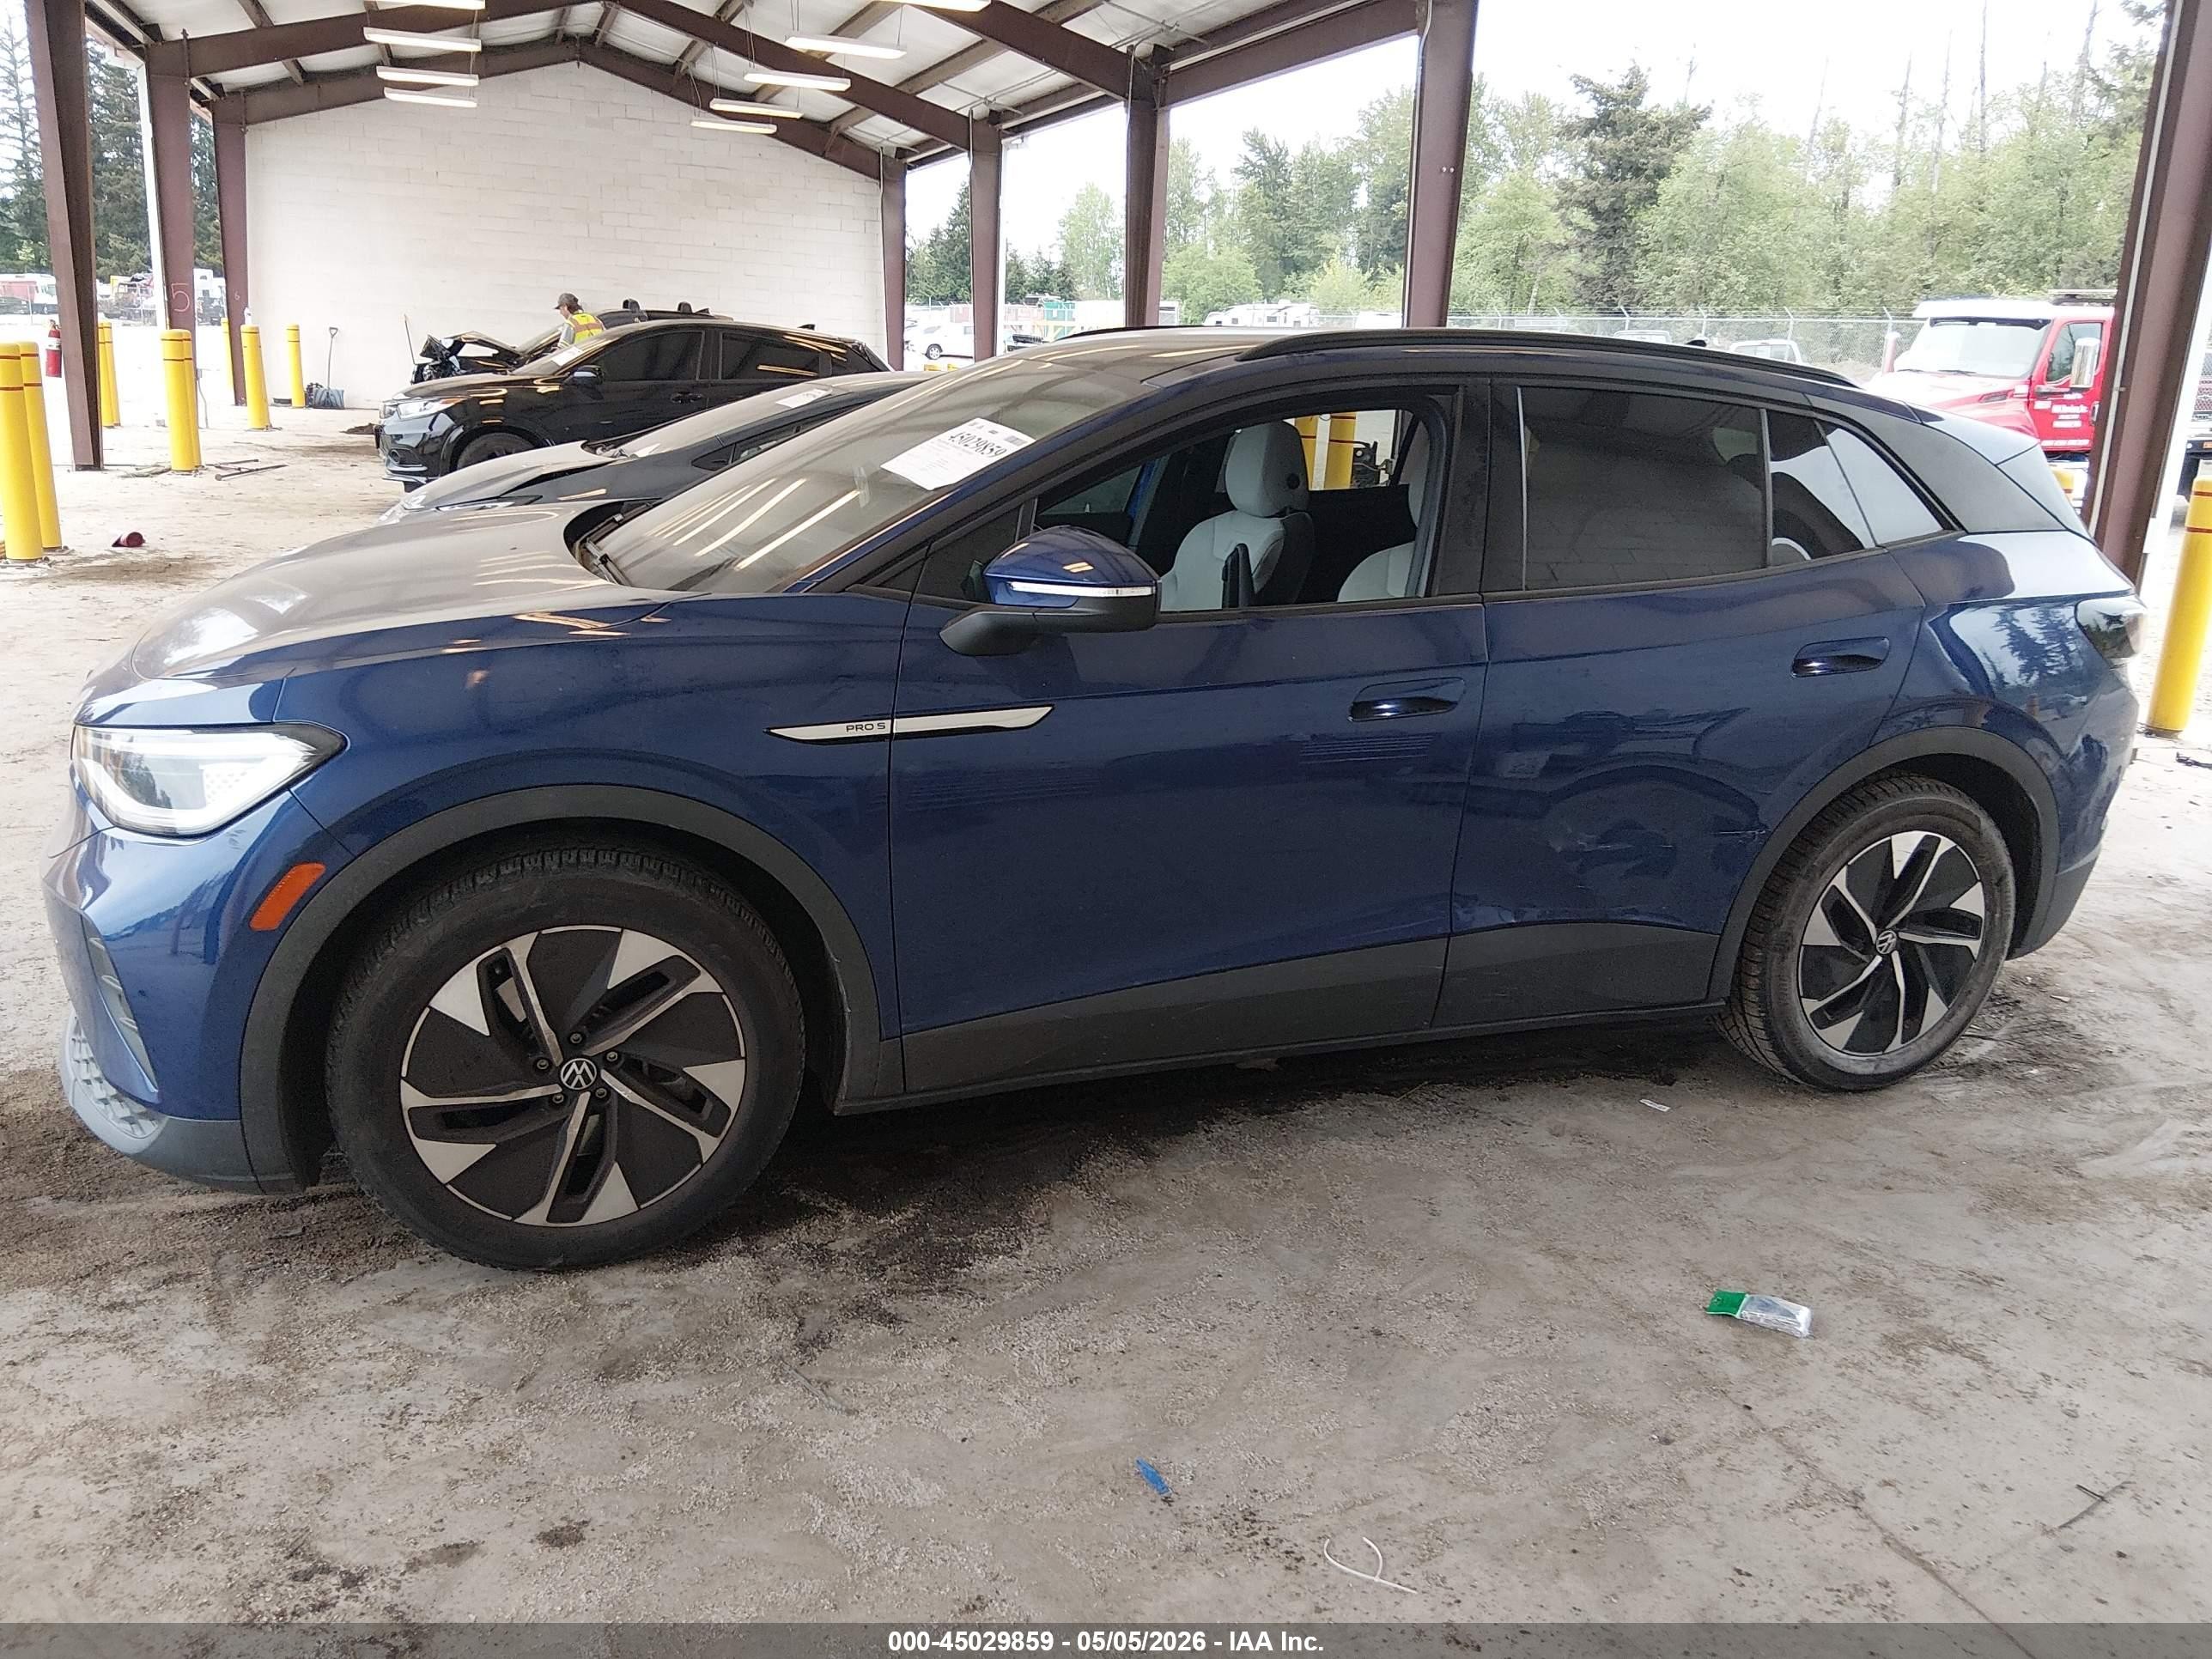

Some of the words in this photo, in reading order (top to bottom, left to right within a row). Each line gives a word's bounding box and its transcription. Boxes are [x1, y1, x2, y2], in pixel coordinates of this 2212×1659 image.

[171, 283, 190, 313] 5
[948, 431, 1007, 459] 45029859
[846, 723, 874, 732] PRO
